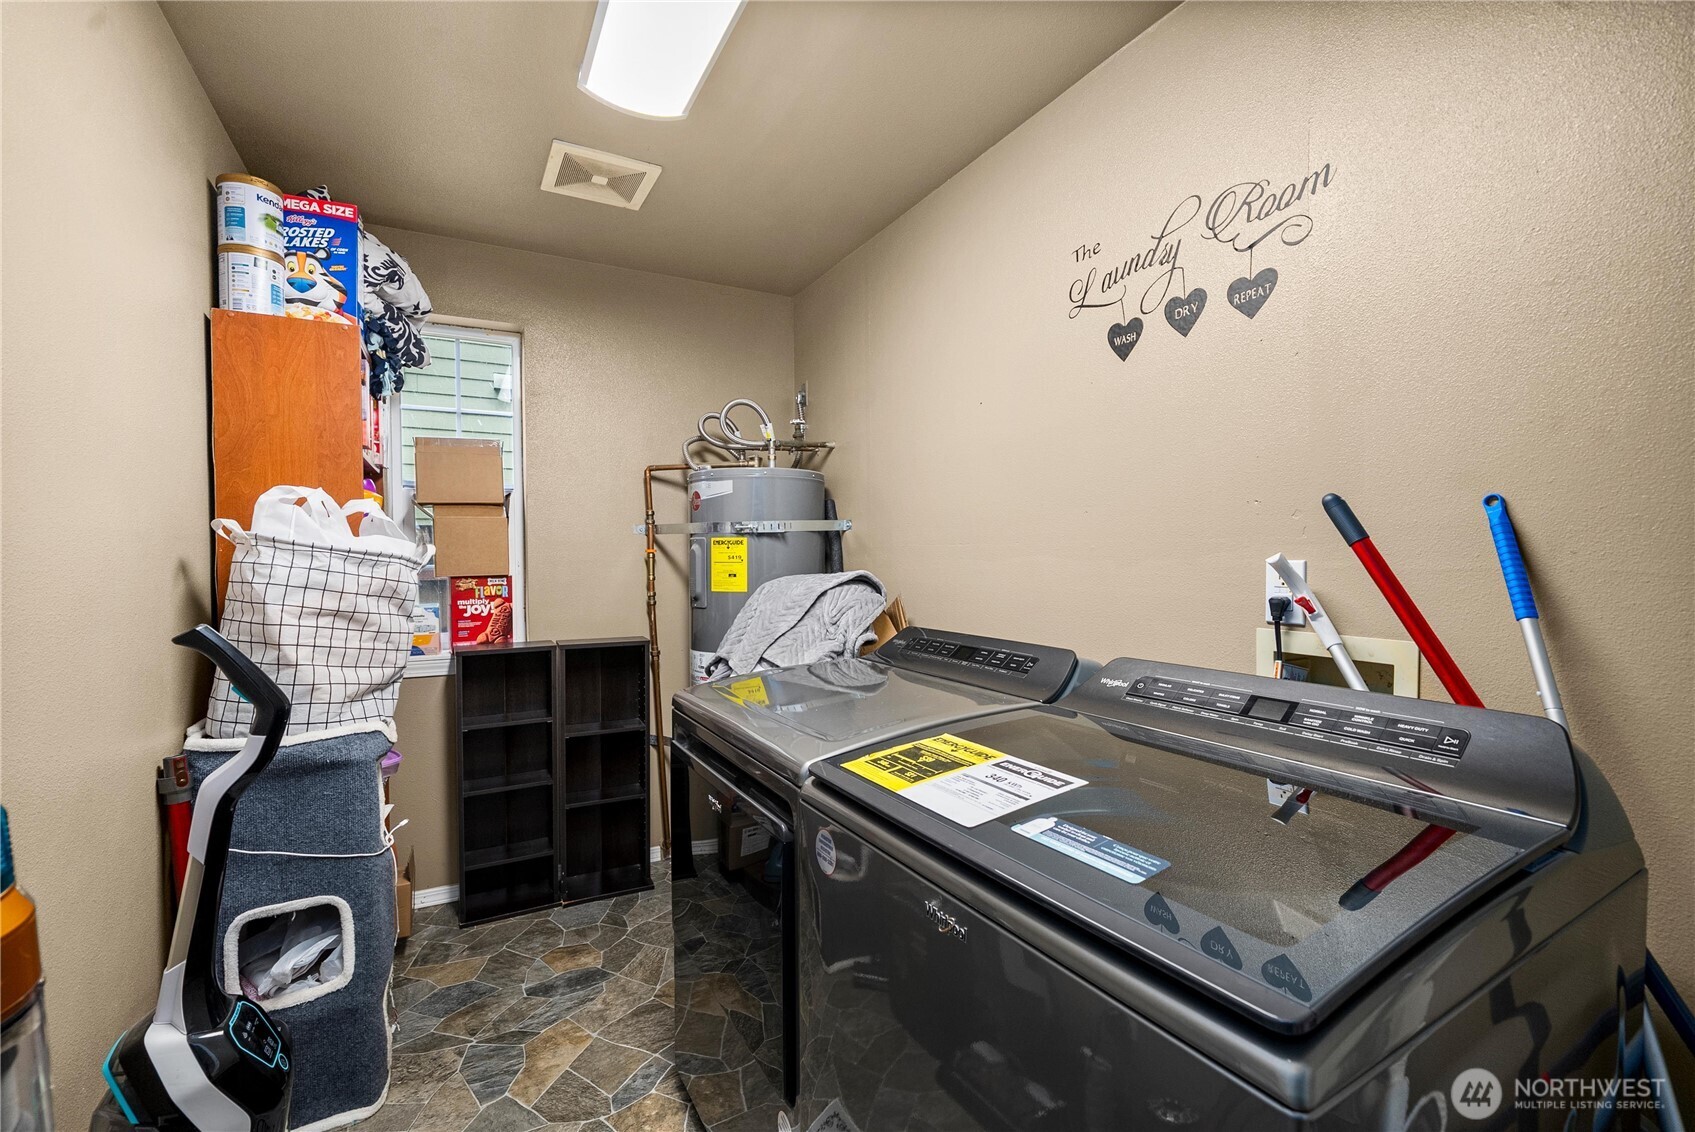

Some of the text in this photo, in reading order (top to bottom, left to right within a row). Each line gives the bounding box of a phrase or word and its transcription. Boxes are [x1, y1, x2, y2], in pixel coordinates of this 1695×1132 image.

[283, 198, 354, 218] MEGA SIZE
[286, 214, 317, 226] Kellogg's
[282, 226, 335, 238] ROSTED
[1068, 162, 1338, 319] Laundry Room
[283, 236, 330, 248] LAKES
[1071, 241, 1101, 262] The
[1232, 282, 1272, 305] REPEAT
[1174, 301, 1199, 320] DRY
[1113, 331, 1137, 346] WASH
[457, 598, 490, 606] multiply
